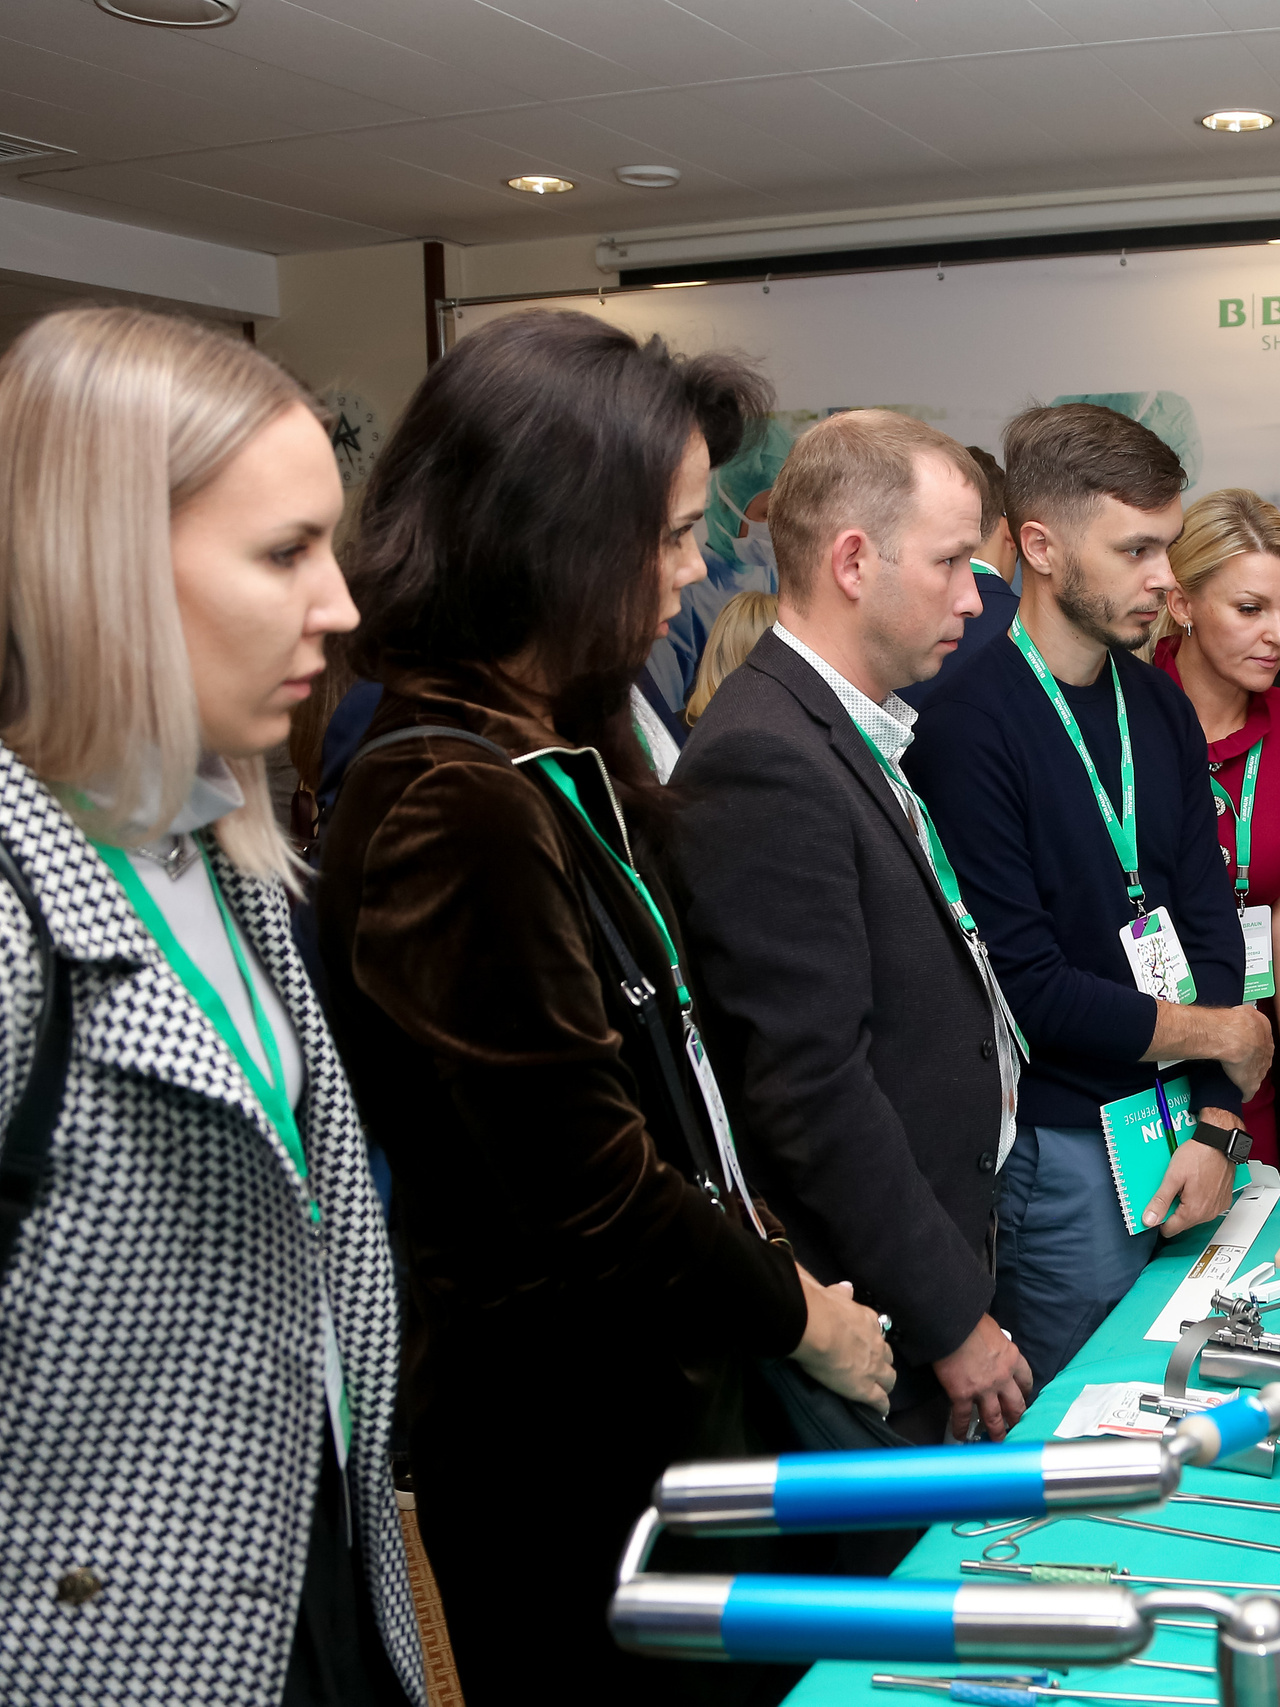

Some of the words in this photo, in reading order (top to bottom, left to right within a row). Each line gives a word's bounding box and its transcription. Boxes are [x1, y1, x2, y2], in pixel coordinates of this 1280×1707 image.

[1219, 298, 1246, 327] B
[1124, 1104, 1159, 1125] XPERTISE
[1141, 1110, 1197, 1143] RAUN
